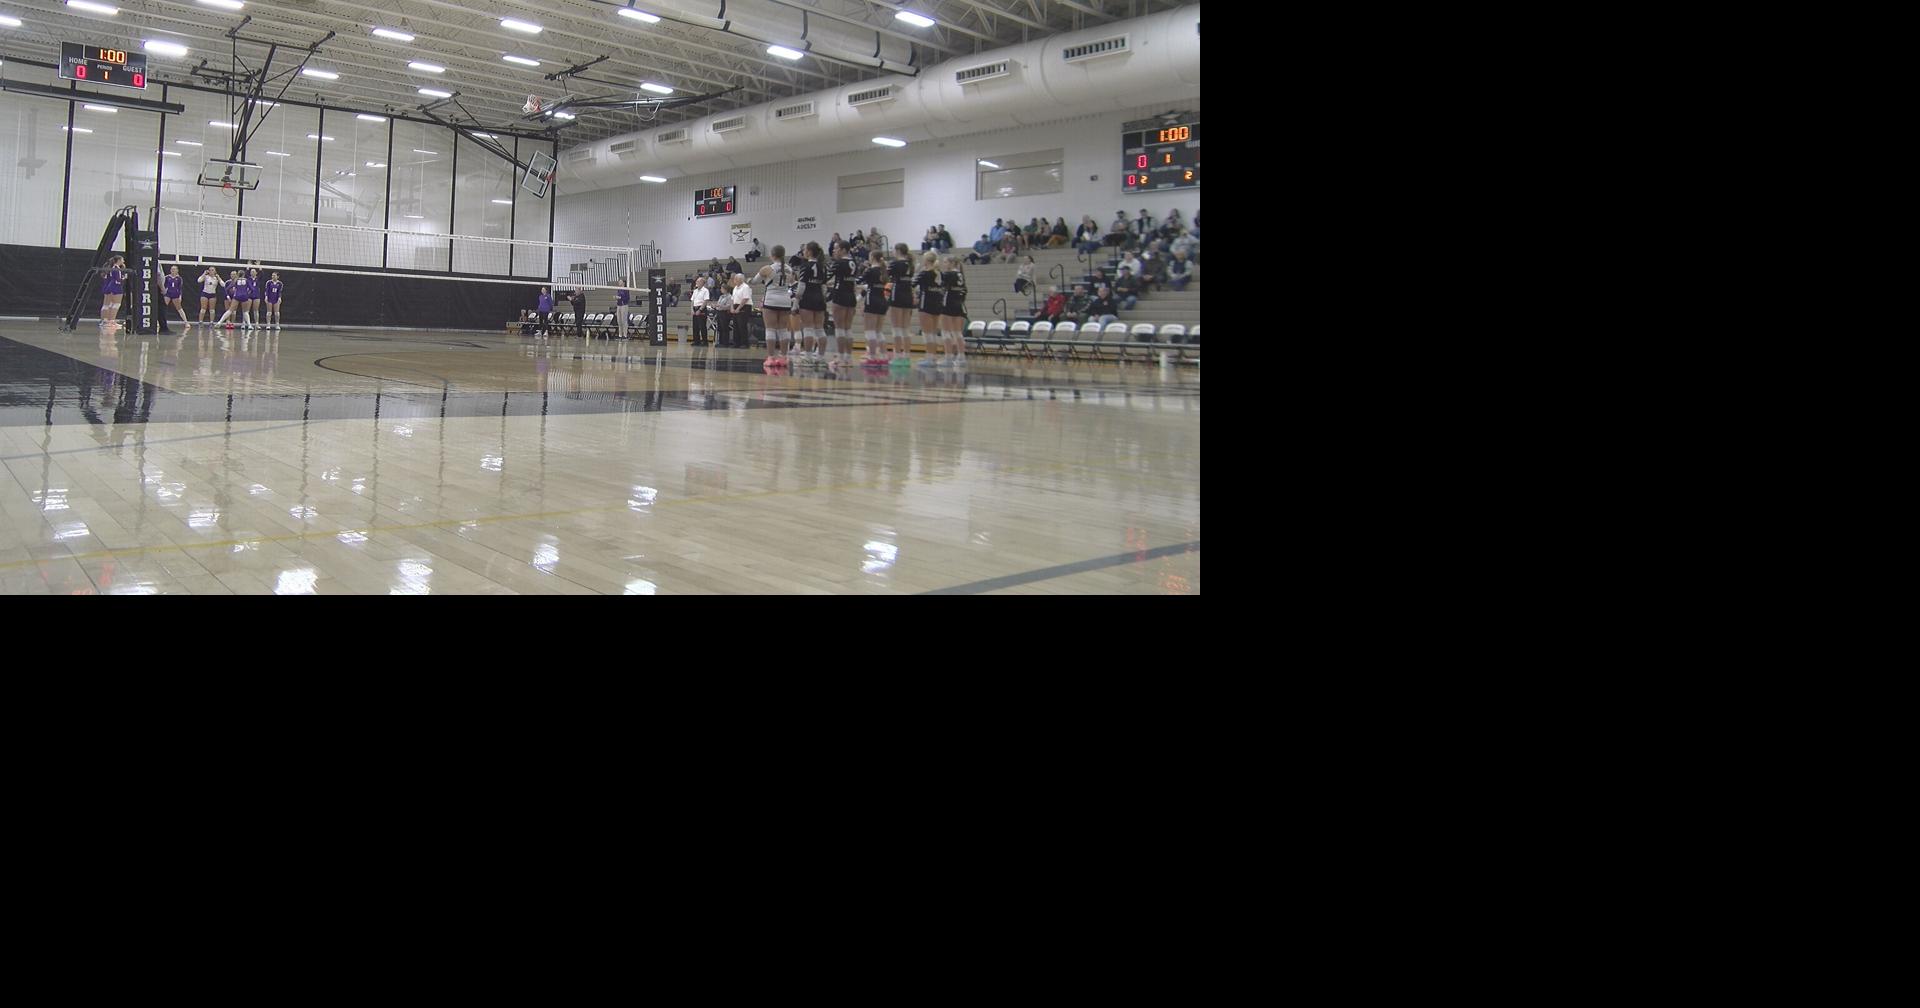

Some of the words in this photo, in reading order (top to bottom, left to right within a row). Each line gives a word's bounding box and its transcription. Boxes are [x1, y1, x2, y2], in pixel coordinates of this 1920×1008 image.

[68, 57, 88, 65] HOME
[100, 48, 125, 63] 1:00
[76, 65, 86, 78] 0
[104, 71, 109, 80] 1
[122, 65, 142, 73] GUEST
[133, 73, 144, 87] 0
[1160, 126, 1189, 142] 1:00
[1138, 154, 1147, 168] 0
[1166, 153, 1171, 164] 1
[1128, 174, 1136, 185] 0
[1140, 175, 1148, 184] 2
[1184, 170, 1193, 180] 2
[811, 263, 818, 278] 1
[142, 256, 153, 328] TBIRDS
[655, 287, 664, 342] TBIRDS
